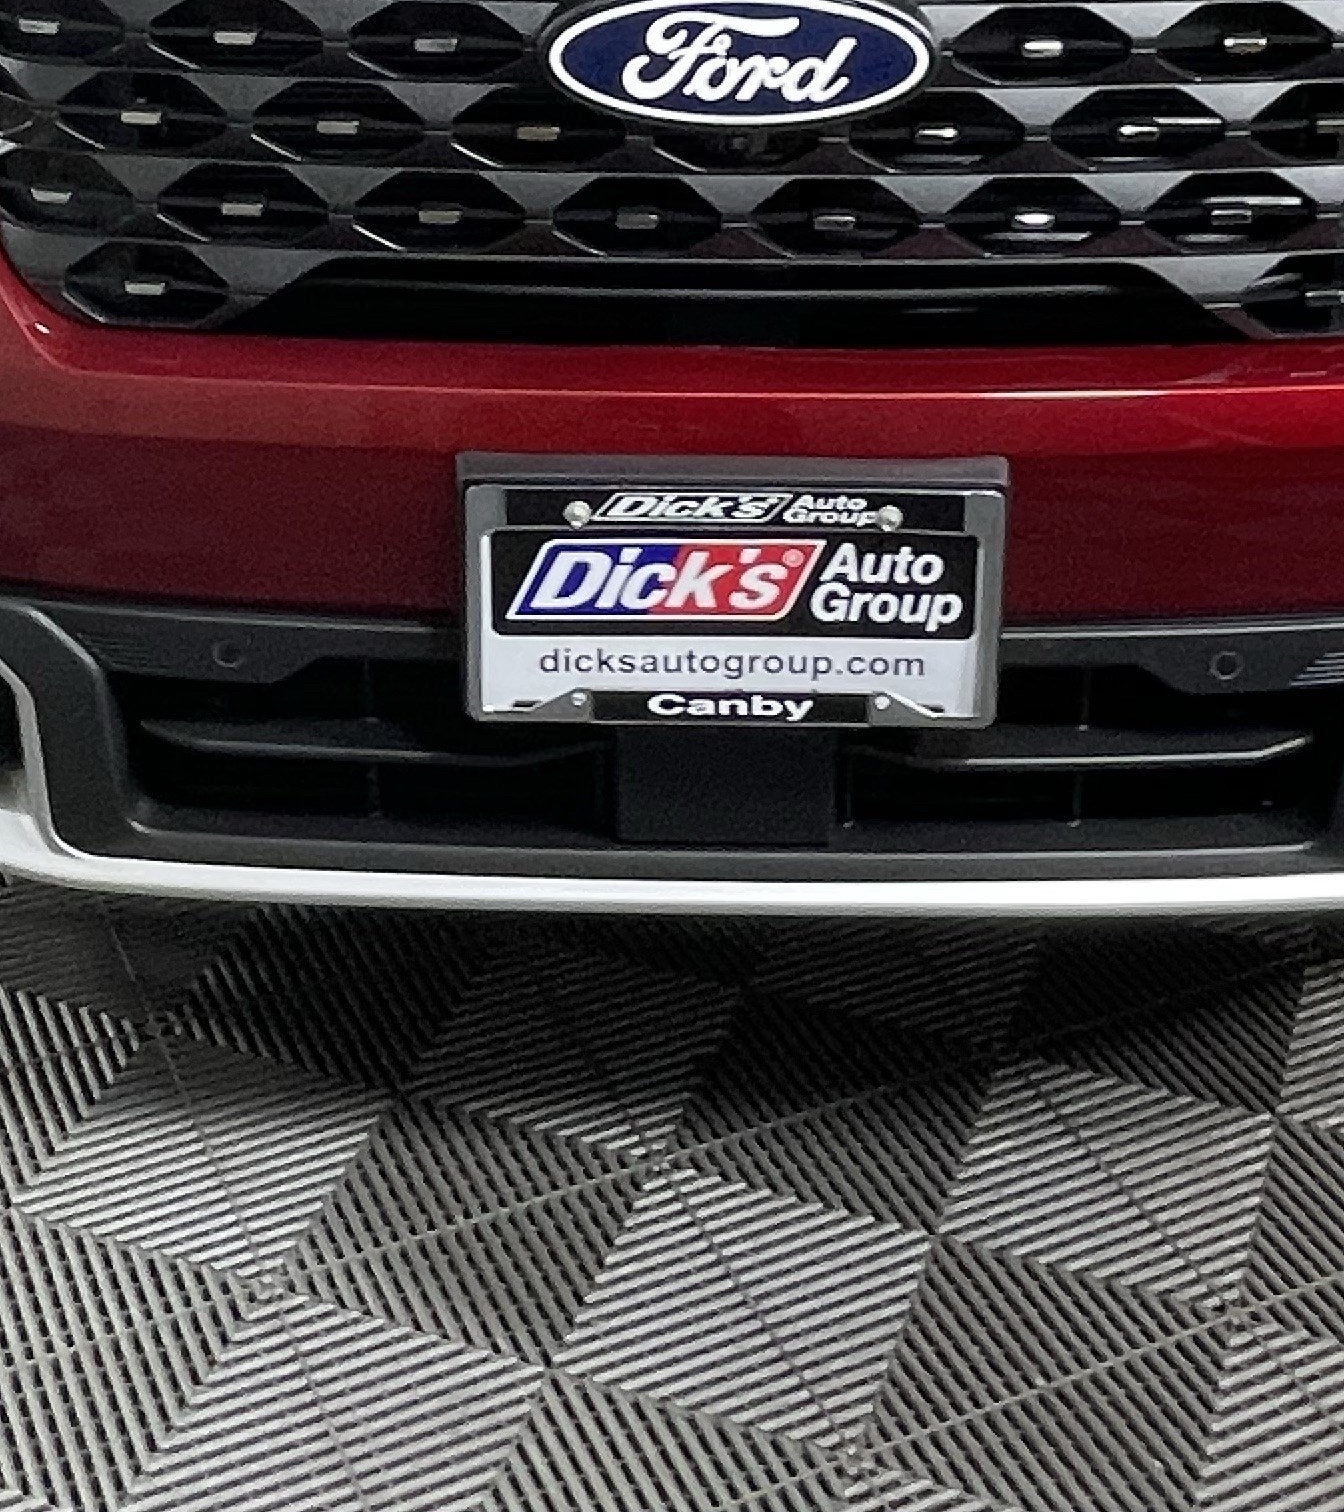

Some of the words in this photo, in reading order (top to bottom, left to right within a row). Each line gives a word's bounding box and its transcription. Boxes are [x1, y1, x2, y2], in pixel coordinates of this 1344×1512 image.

[622, 10, 857, 102] Ford
[609, 494, 770, 519] Dick's
[782, 510, 881, 526] Group
[793, 495, 868, 511] Auto
[529, 545, 783, 610] Dick's
[820, 543, 945, 585] Auto
[810, 585, 963, 631] Group
[539, 648, 926, 682] dicksautogroup.com
[647, 693, 813, 721] Canby
